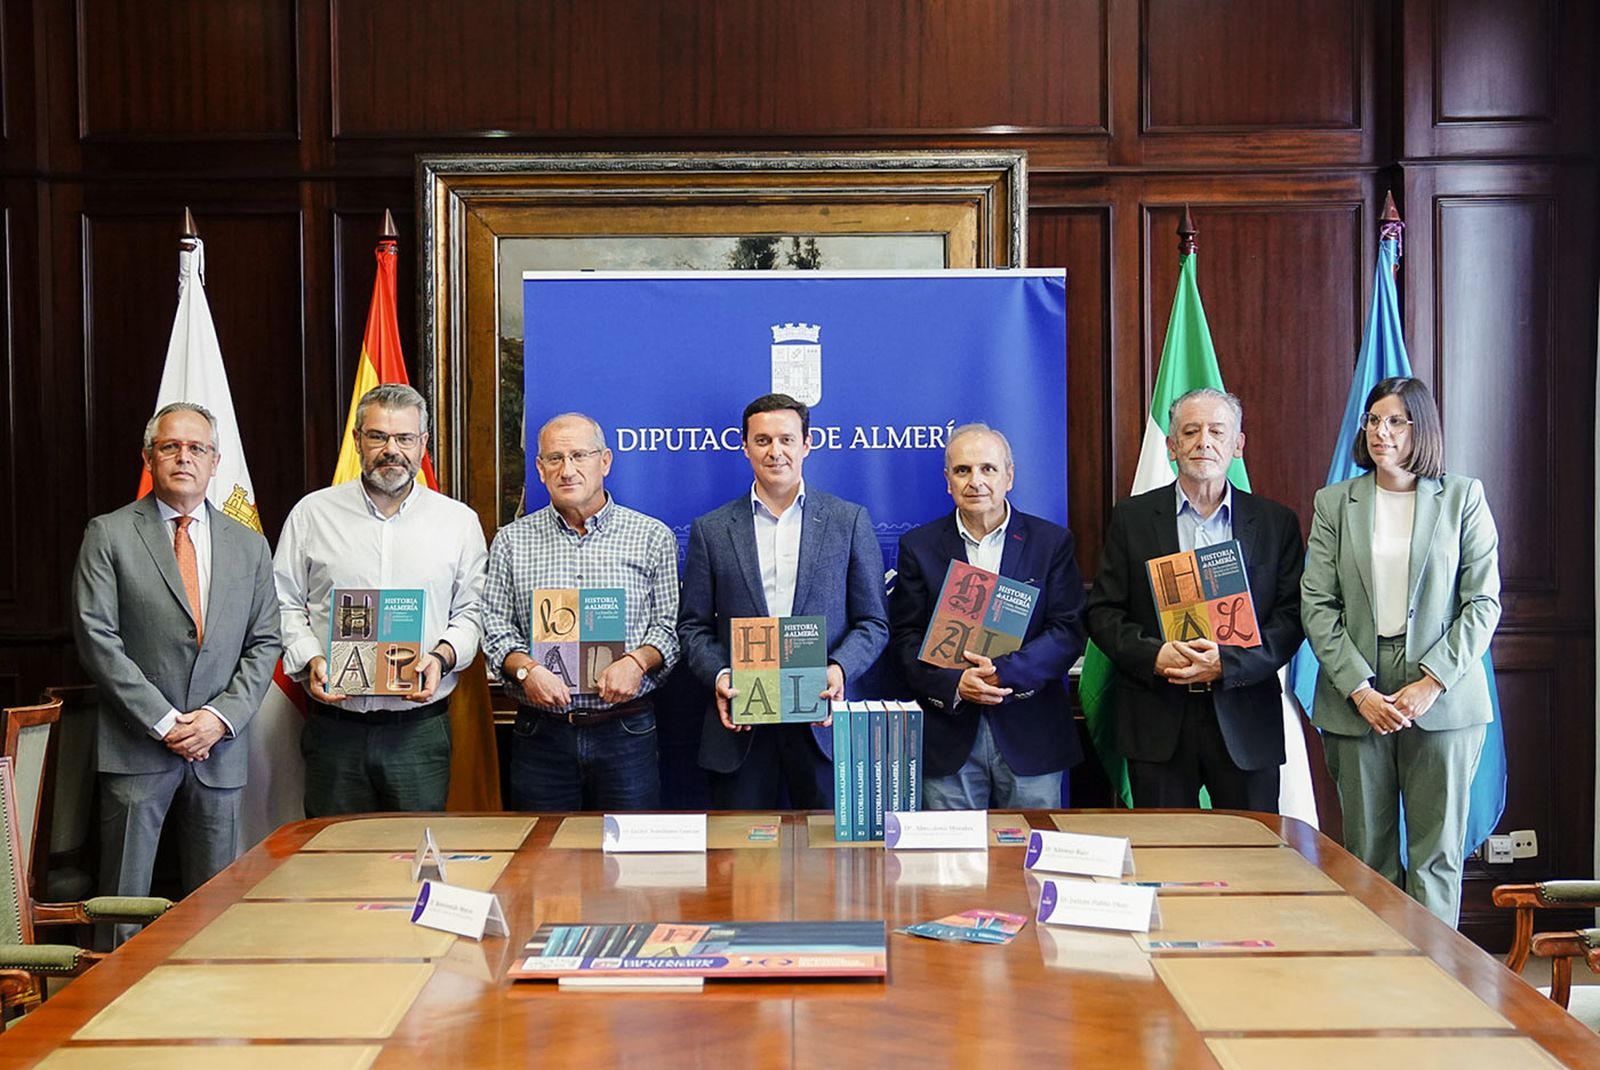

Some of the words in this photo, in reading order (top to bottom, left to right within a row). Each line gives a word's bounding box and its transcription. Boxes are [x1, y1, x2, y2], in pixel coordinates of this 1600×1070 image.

[616, 427, 743, 451] DIPUTAC
[811, 427, 843, 449] DE
[849, 420, 956, 449] ALMERÍ
[1200, 549, 1235, 562] HISTORIA
[998, 584, 1032, 602] HISTORIA
[784, 623, 818, 631] HISTORIA
[738, 625, 776, 662] H
[334, 645, 371, 688] A
[740, 676, 777, 716] A
[788, 675, 819, 714] L
